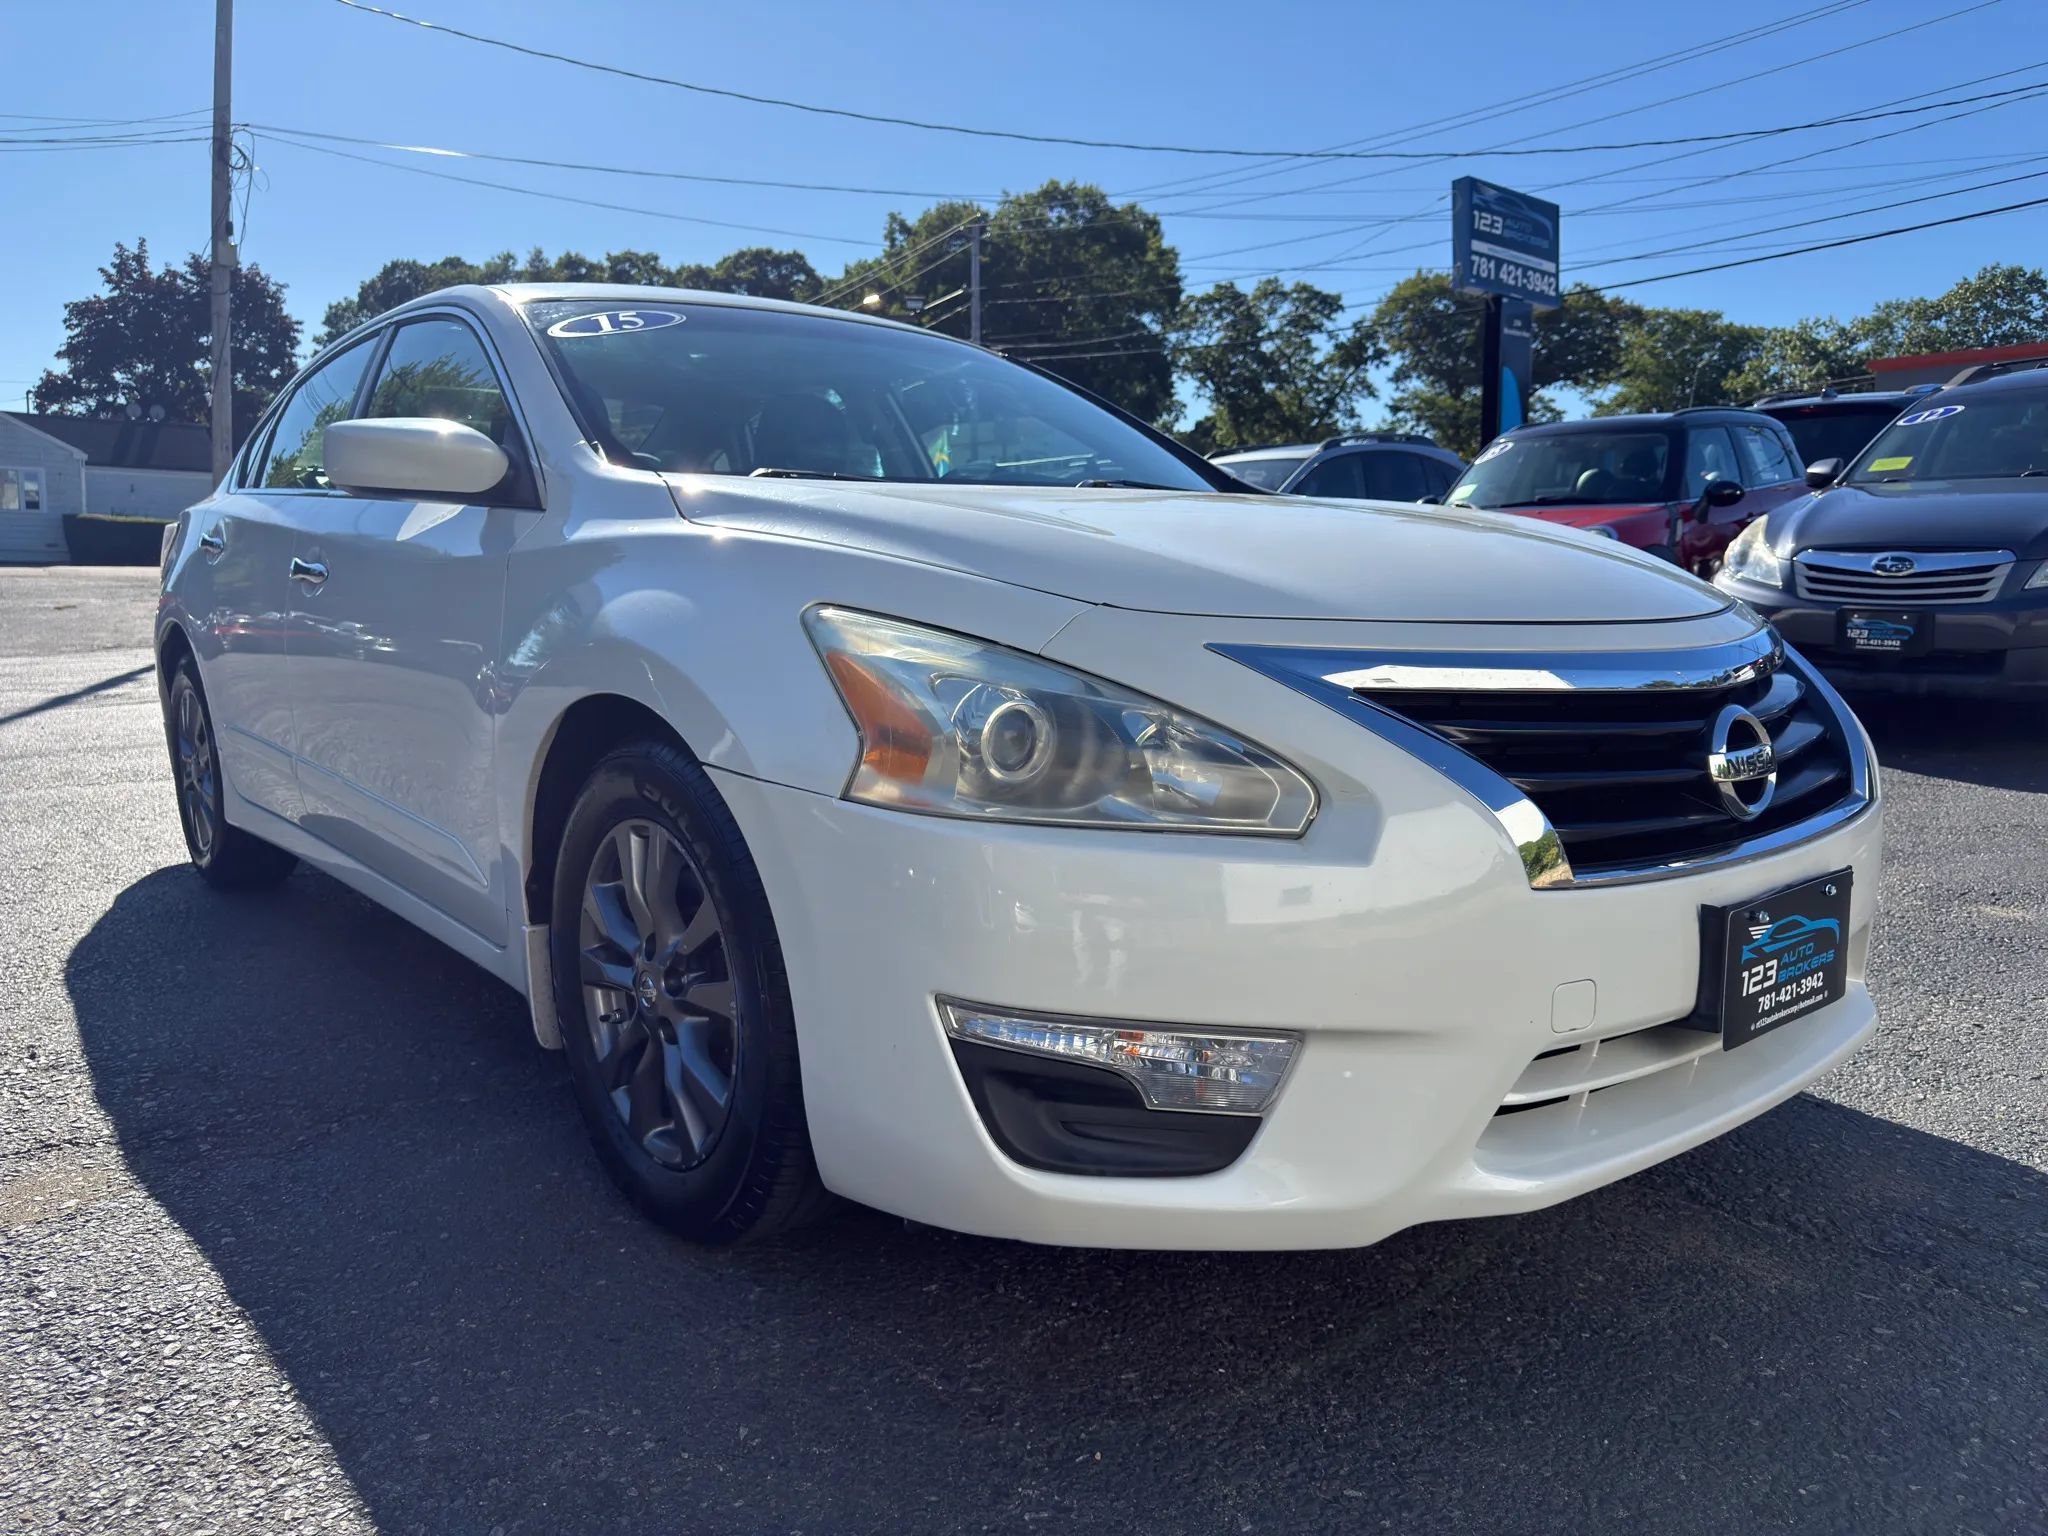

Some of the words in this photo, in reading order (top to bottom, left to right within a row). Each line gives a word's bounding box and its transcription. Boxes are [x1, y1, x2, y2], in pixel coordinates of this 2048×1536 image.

[1473, 210, 1503, 235] 123
[1471, 254, 1496, 280] 781
[1499, 262, 1557, 297] 421-3942
[591, 312, 645, 333] 15
[1847, 629, 1869, 638] 123
[1778, 949, 1835, 984] BROKERS
[1781, 942, 1815, 966] AUTO
[1742, 959, 1778, 997] 123
[1758, 971, 1823, 1013] 781-421-3942
